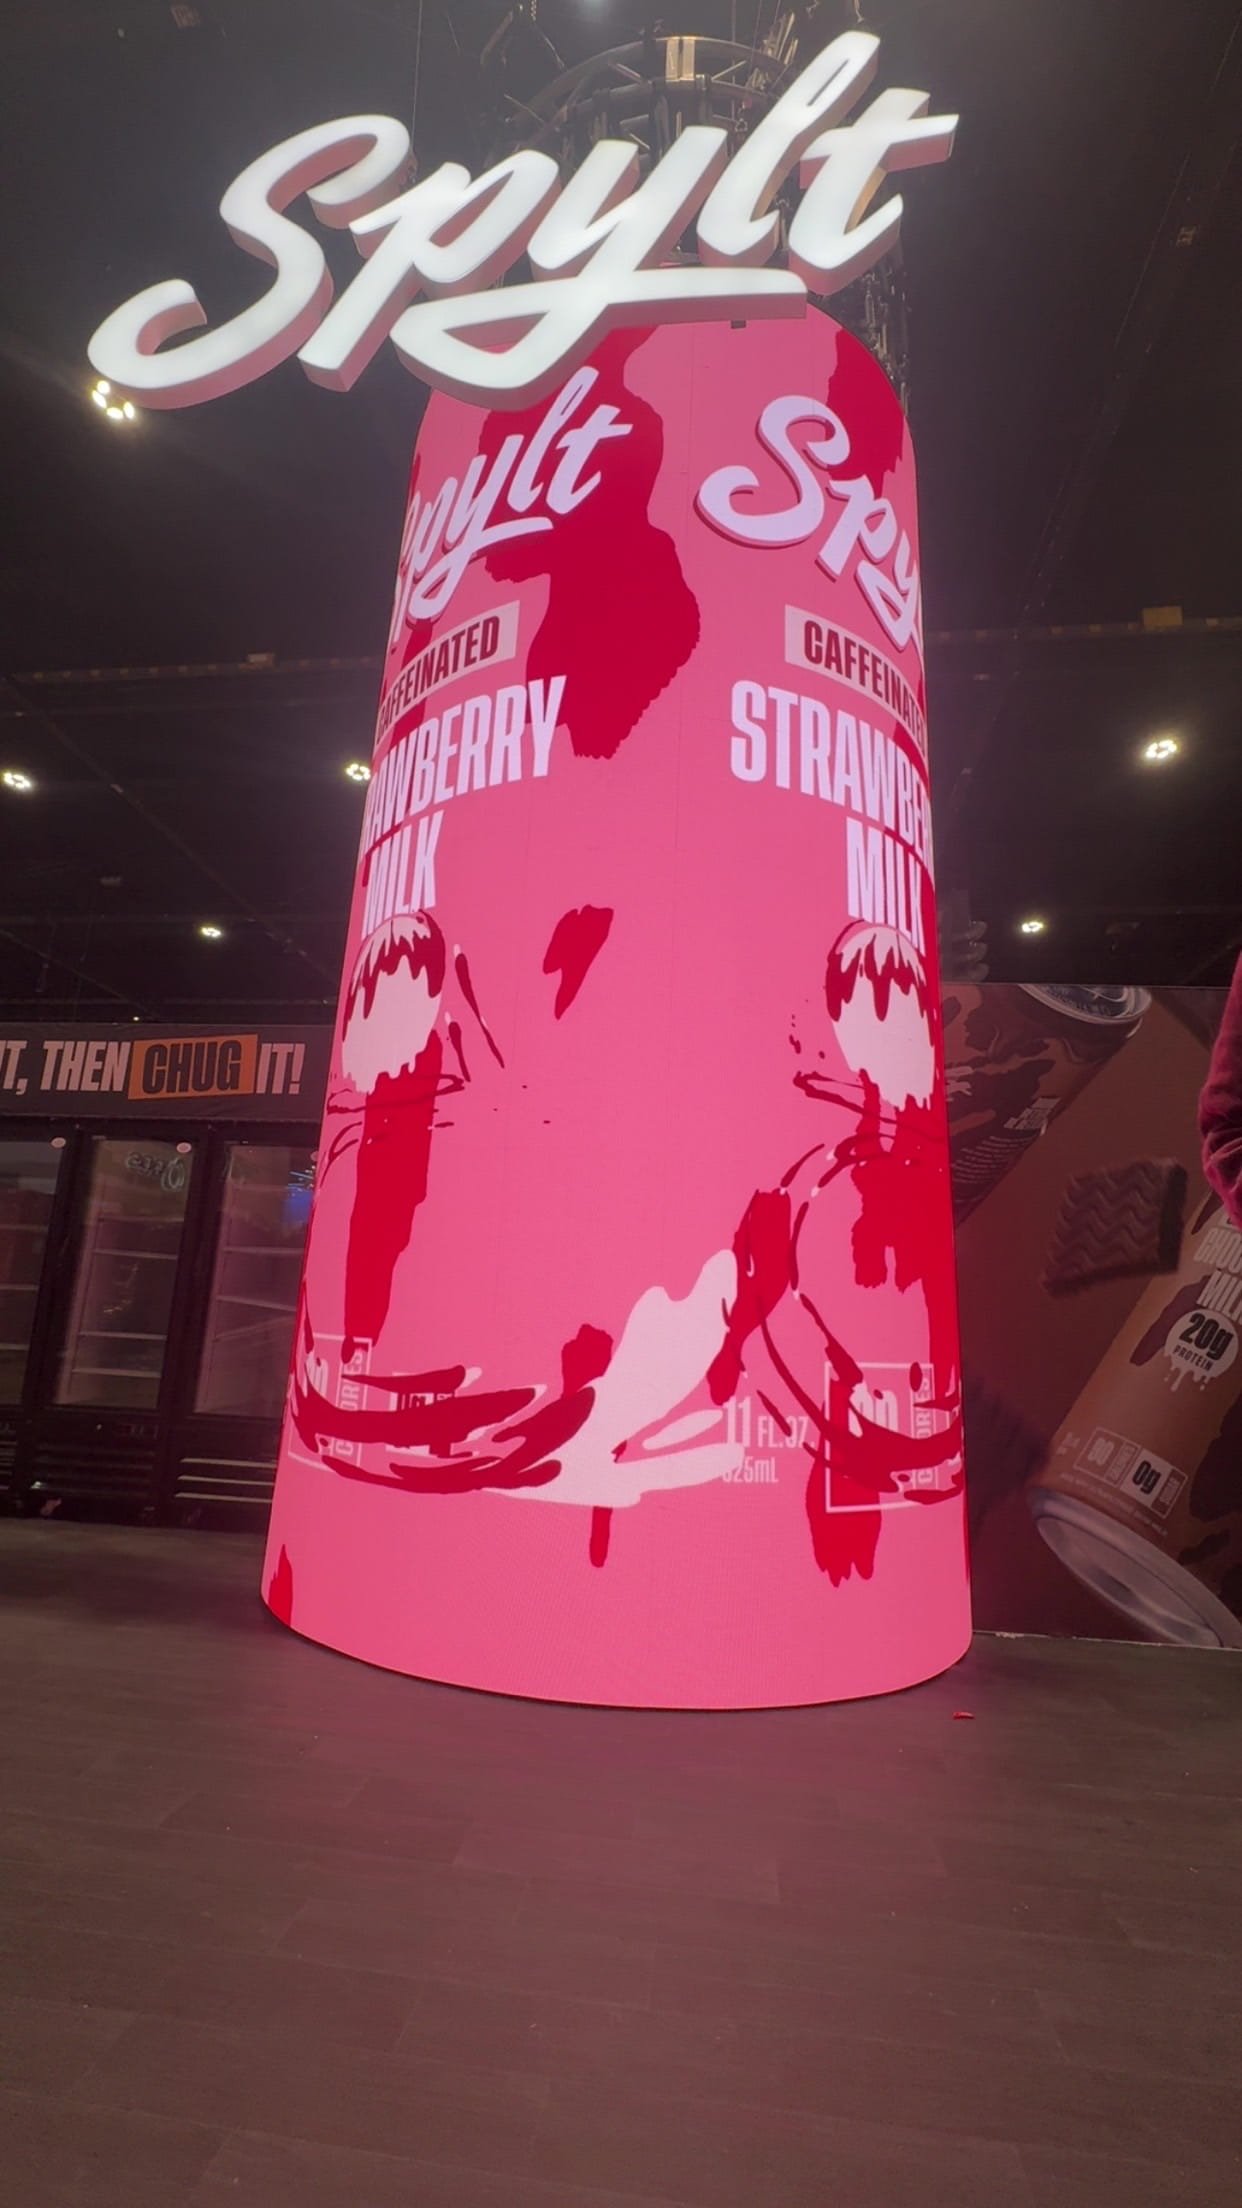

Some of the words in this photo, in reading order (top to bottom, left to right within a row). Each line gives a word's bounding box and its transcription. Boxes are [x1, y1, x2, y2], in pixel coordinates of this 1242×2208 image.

[87, 29, 959, 408] Spylt
[361, 809, 444, 941] MILK
[846, 816, 926, 957] MILK
[40, 1040, 131, 1092] THEN
[142, 1039, 242, 1095] CHUG
[255, 1042, 305, 1095] IT!
[1173, 1344, 1214, 1372] PROTEIN
[1179, 1312, 1234, 1361] 20g
[722, 1396, 751, 1448] 11
[1132, 1460, 1161, 1494] 0g
